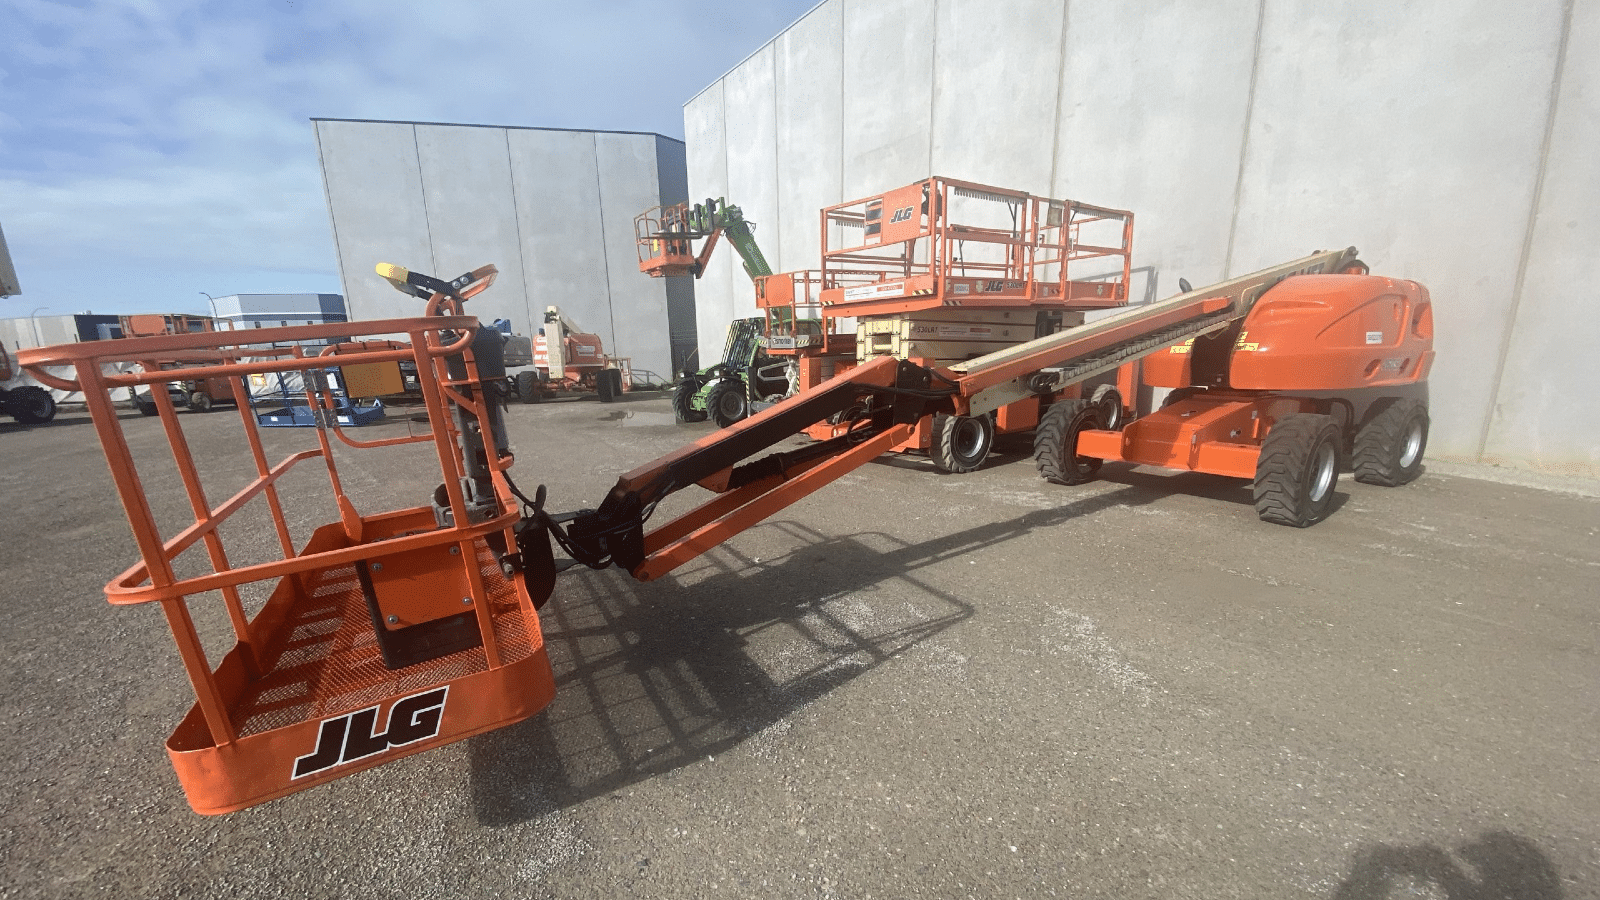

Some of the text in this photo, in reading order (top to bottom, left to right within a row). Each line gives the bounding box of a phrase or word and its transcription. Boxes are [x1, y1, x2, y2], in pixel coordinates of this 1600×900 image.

[889, 206, 915, 224] JLG
[985, 281, 1003, 292] JLG
[291, 685, 449, 780] JLG
